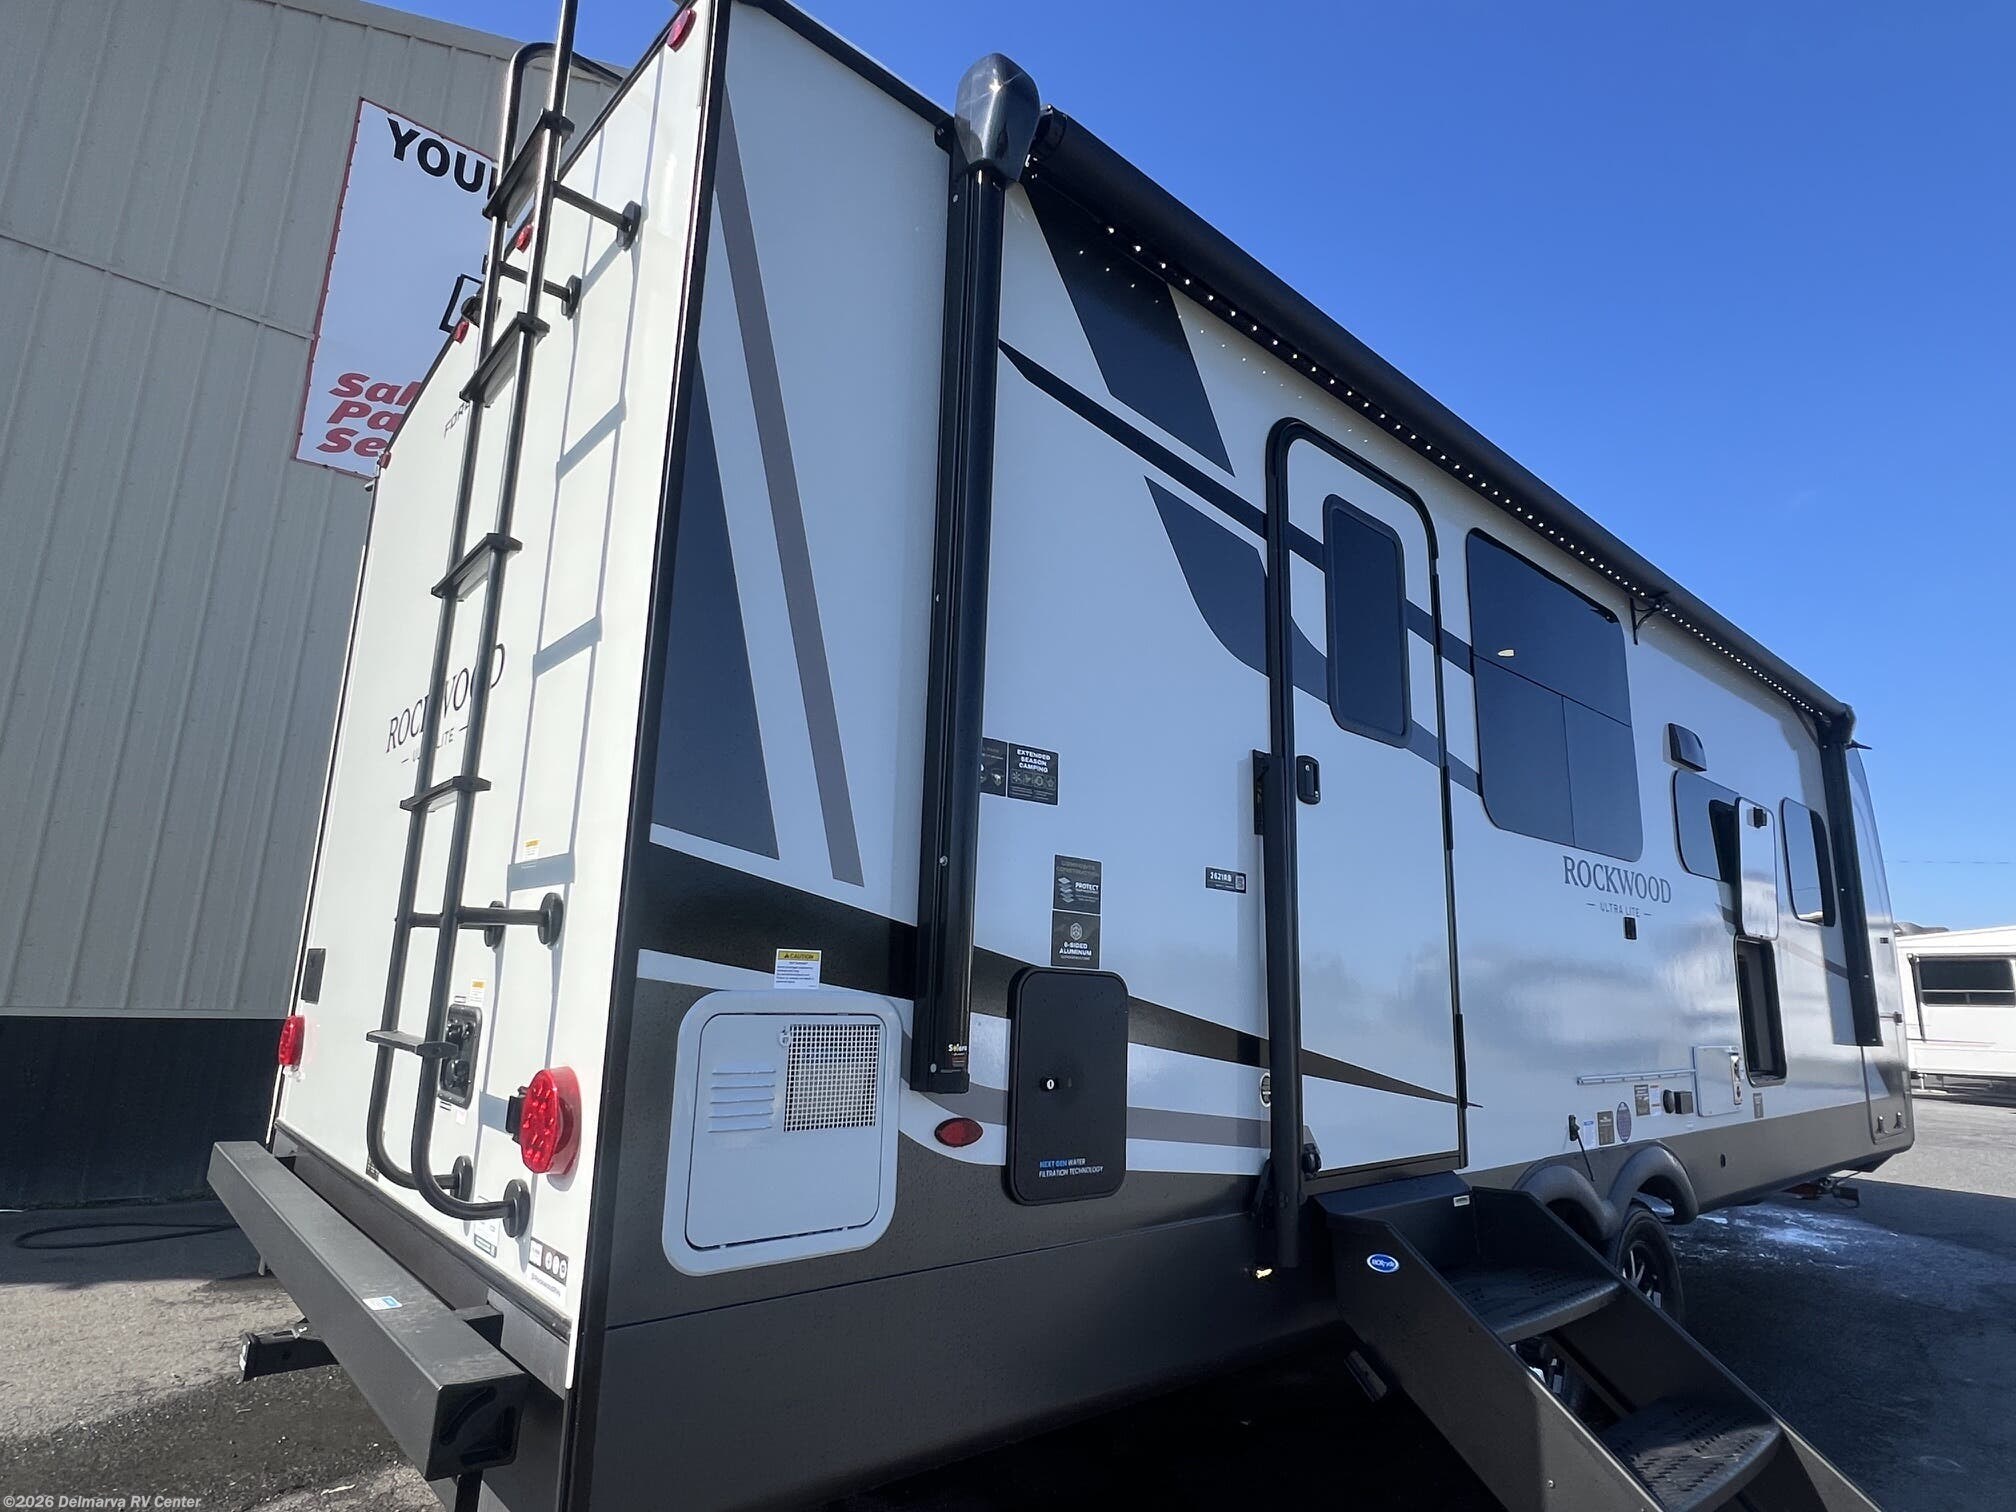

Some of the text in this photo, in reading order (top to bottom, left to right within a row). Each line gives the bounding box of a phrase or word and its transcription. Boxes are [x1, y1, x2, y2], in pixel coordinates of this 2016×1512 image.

[1016, 748, 1051, 761] EXTENDED
[1020, 756, 1047, 767] SEASON
[1018, 762, 1049, 773] CAMPING
[1563, 855, 1672, 904] ROCKWOOD
[1074, 881, 1099, 892] PROTECT
[1600, 902, 1641, 918] ULTRA LITE
[1059, 947, 1092, 957] ALUMINUM
[1068, 1158, 1086, 1166] WATER
[1039, 1166, 1104, 1178] FILTRATION TECHNOLOGY
